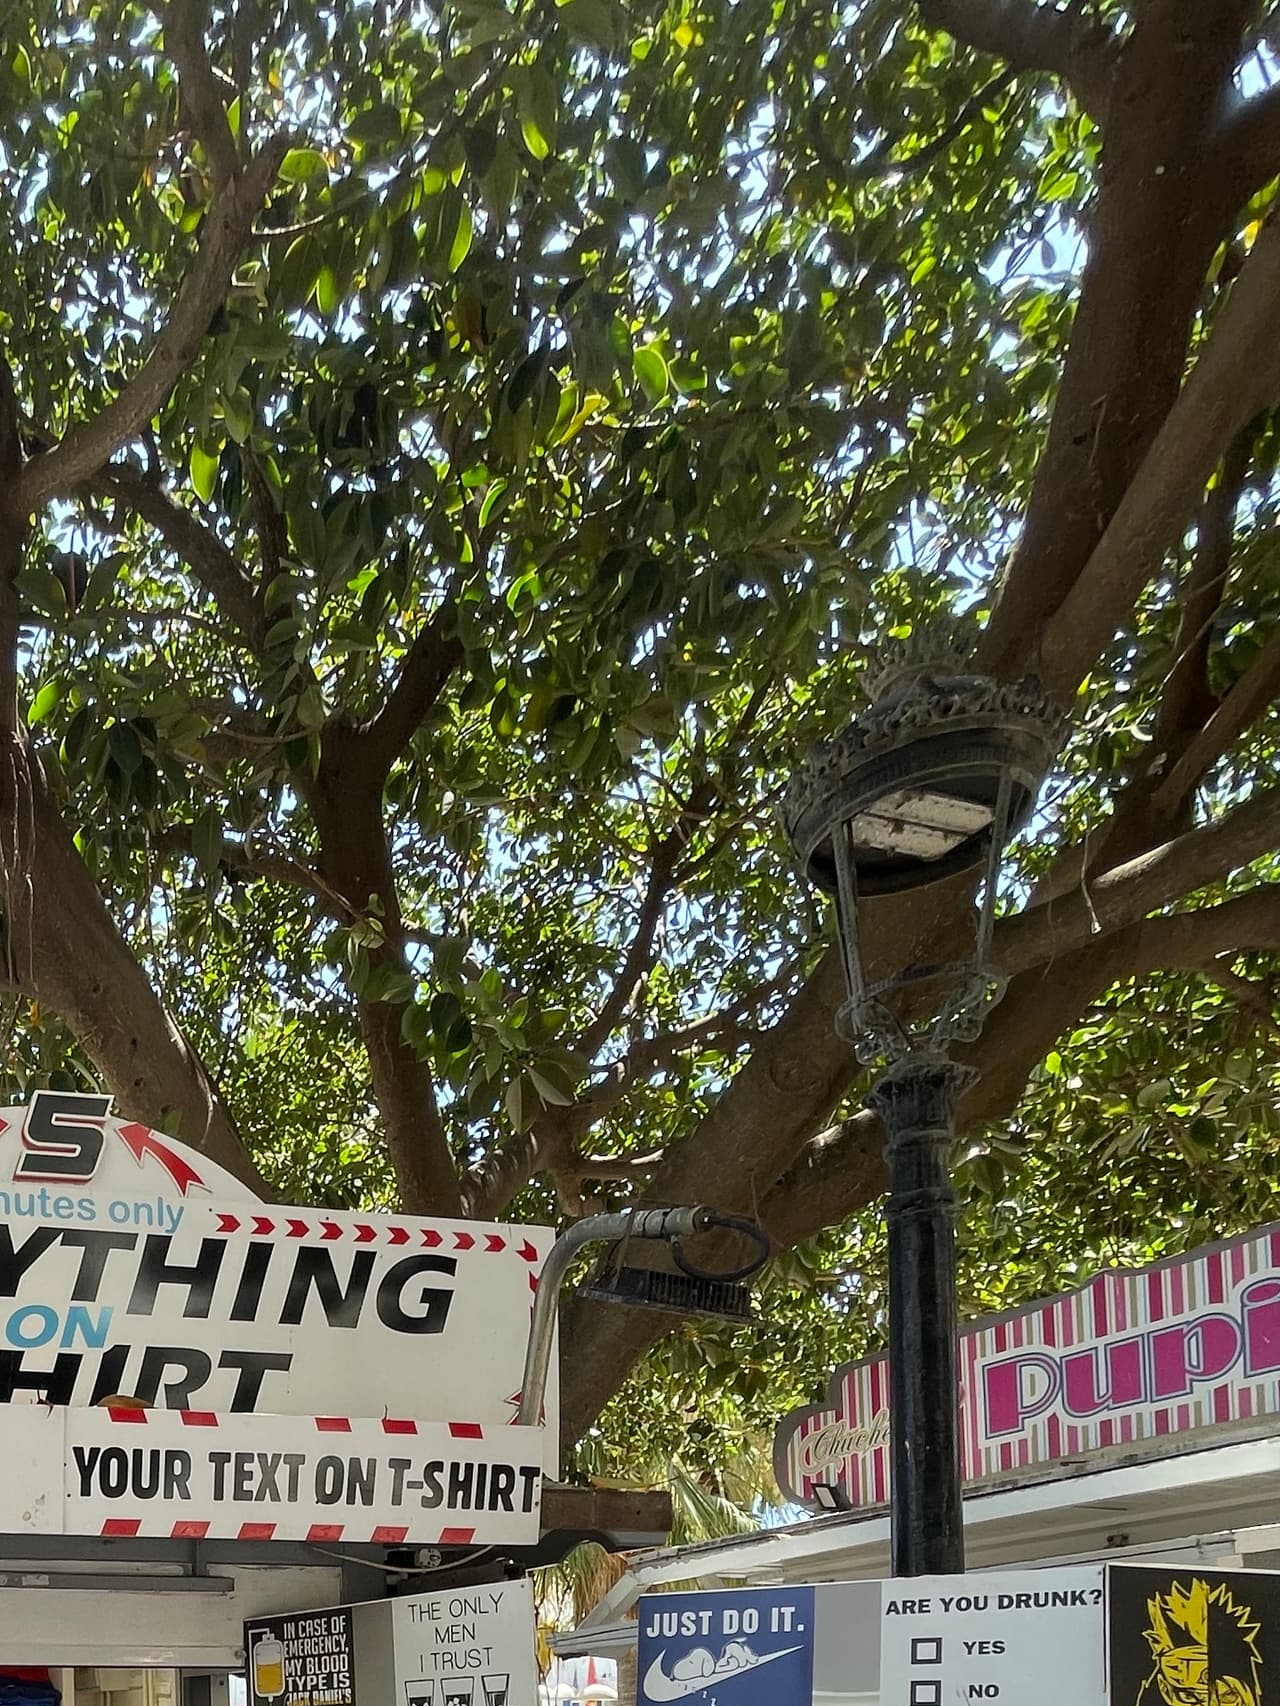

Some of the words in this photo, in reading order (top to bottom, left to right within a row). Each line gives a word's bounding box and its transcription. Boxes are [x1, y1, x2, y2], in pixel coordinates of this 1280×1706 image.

[14, 1090, 114, 1184] 5
[108, 1193, 185, 1234] only
[5, 1304, 114, 1349] ON
[73, 1446, 191, 1500] YOUR
[208, 1452, 307, 1502] TEXT
[314, 1456, 377, 1507] ON
[389, 1458, 541, 1514] T-SHIRT
[408, 1604, 440, 1623] THE
[449, 1592, 504, 1618] ONLY
[885, 1598, 931, 1615] ARE
[939, 1596, 989, 1613] YOU
[997, 1589, 1102, 1611] DRUNK?
[283, 1623, 296, 1638] IN
[298, 1619, 327, 1637] CASE
[329, 1616, 347, 1633] OF
[646, 1609, 713, 1639] JUST
[723, 1608, 759, 1635] DO
[771, 1606, 805, 1633] IT.
[435, 1624, 475, 1645] MEN
[284, 1636, 350, 1657] EMERGENCY,
[963, 1640, 1006, 1656] YES
[285, 1659, 304, 1676] MY
[306, 1654, 348, 1675] BLOOD
[430, 1647, 493, 1670] TRUST
[286, 1674, 328, 1690] TYPE
[332, 1673, 350, 1688] IS
[969, 1684, 1000, 1699] NO
[287, 1692, 310, 1706] JACK
